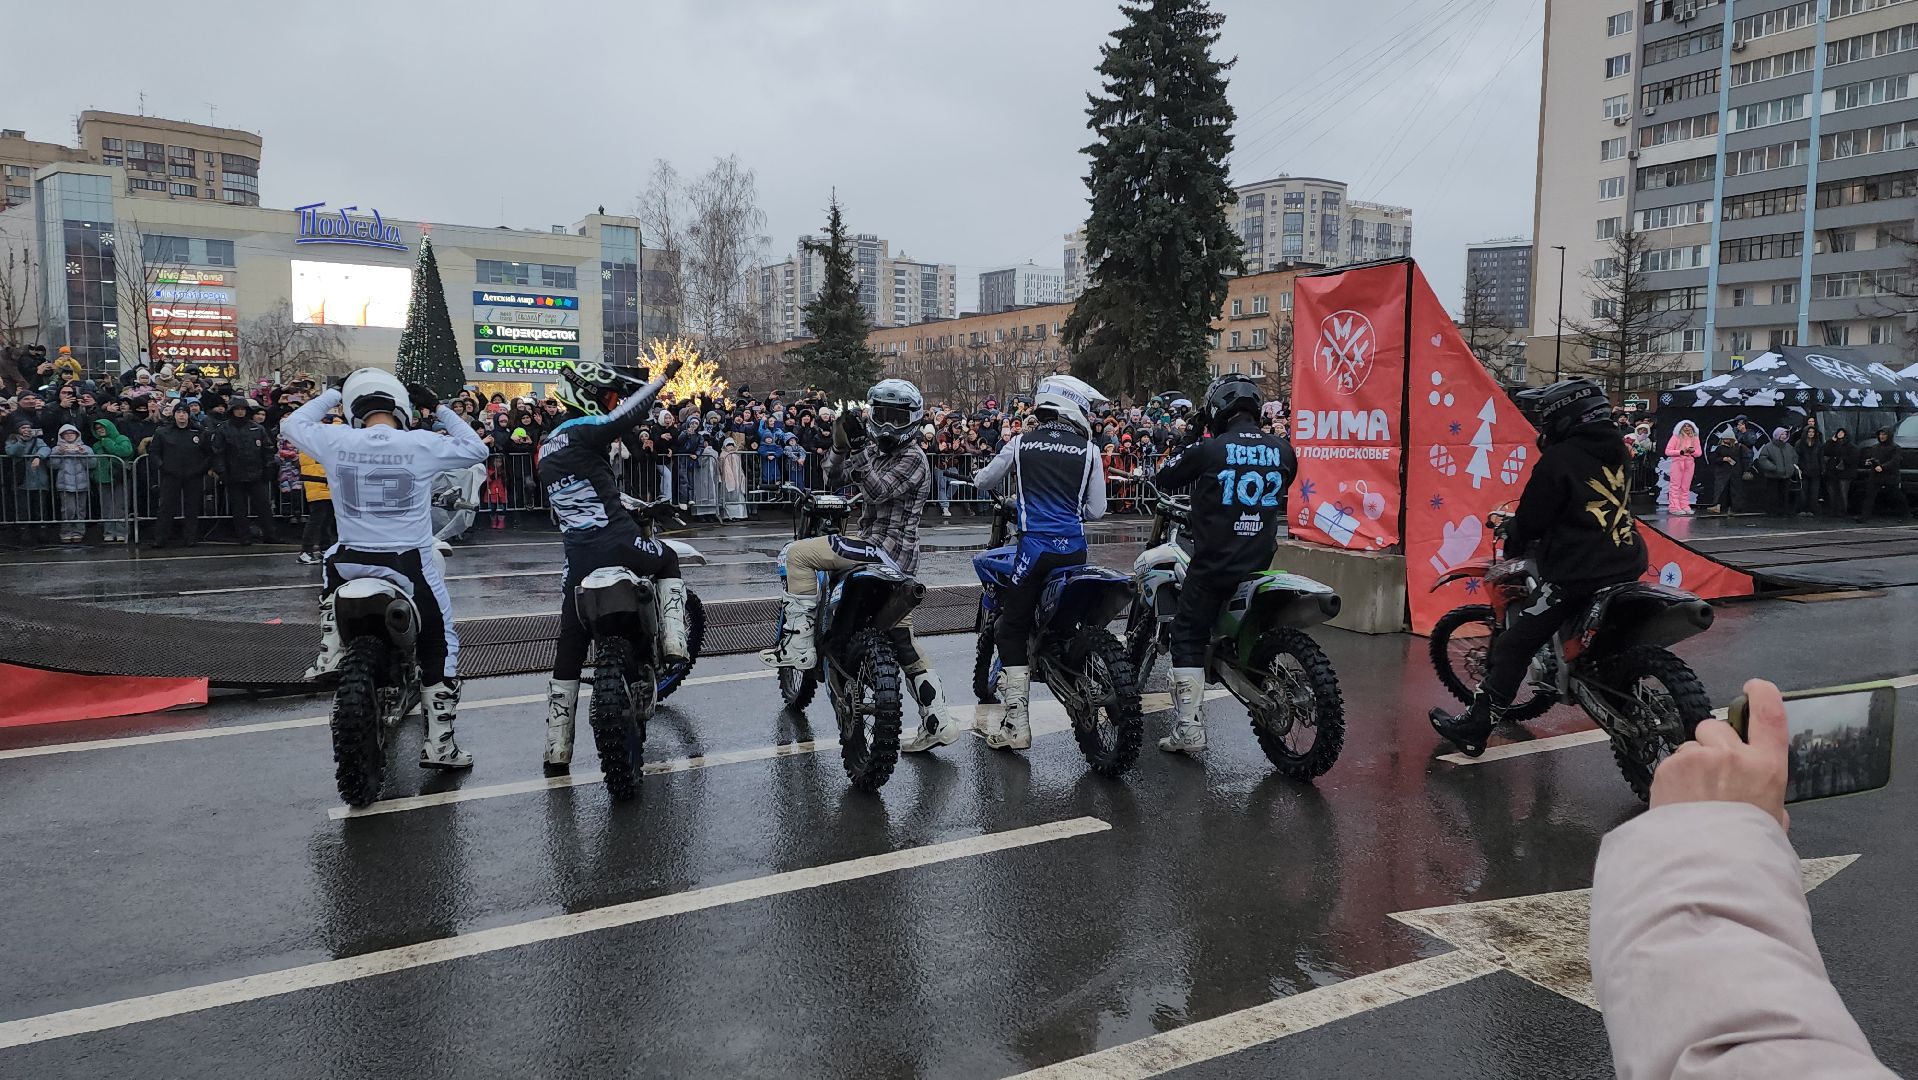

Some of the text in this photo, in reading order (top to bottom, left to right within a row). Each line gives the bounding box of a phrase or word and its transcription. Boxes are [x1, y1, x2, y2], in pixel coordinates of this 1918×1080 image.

[295, 201, 402, 243] Победа
[482, 292, 535, 306] Детский мир
[151, 308, 188, 318] DNS
[496, 325, 577, 341] Перекресток
[157, 346, 232, 357] ХОЗМАКС
[491, 344, 565, 356] СУПЕРМАРКЕТ
[1295, 408, 1391, 441] ЗИМА
[1020, 440, 1087, 456] MYASNIKOV
[1225, 443, 1281, 467] ICEIN
[1295, 447, 1391, 461] В ПОДМОСКОВЬЕ
[336, 464, 416, 518] 13
[1217, 469, 1283, 507] 102
[1233, 521, 1264, 532] GORILLA
